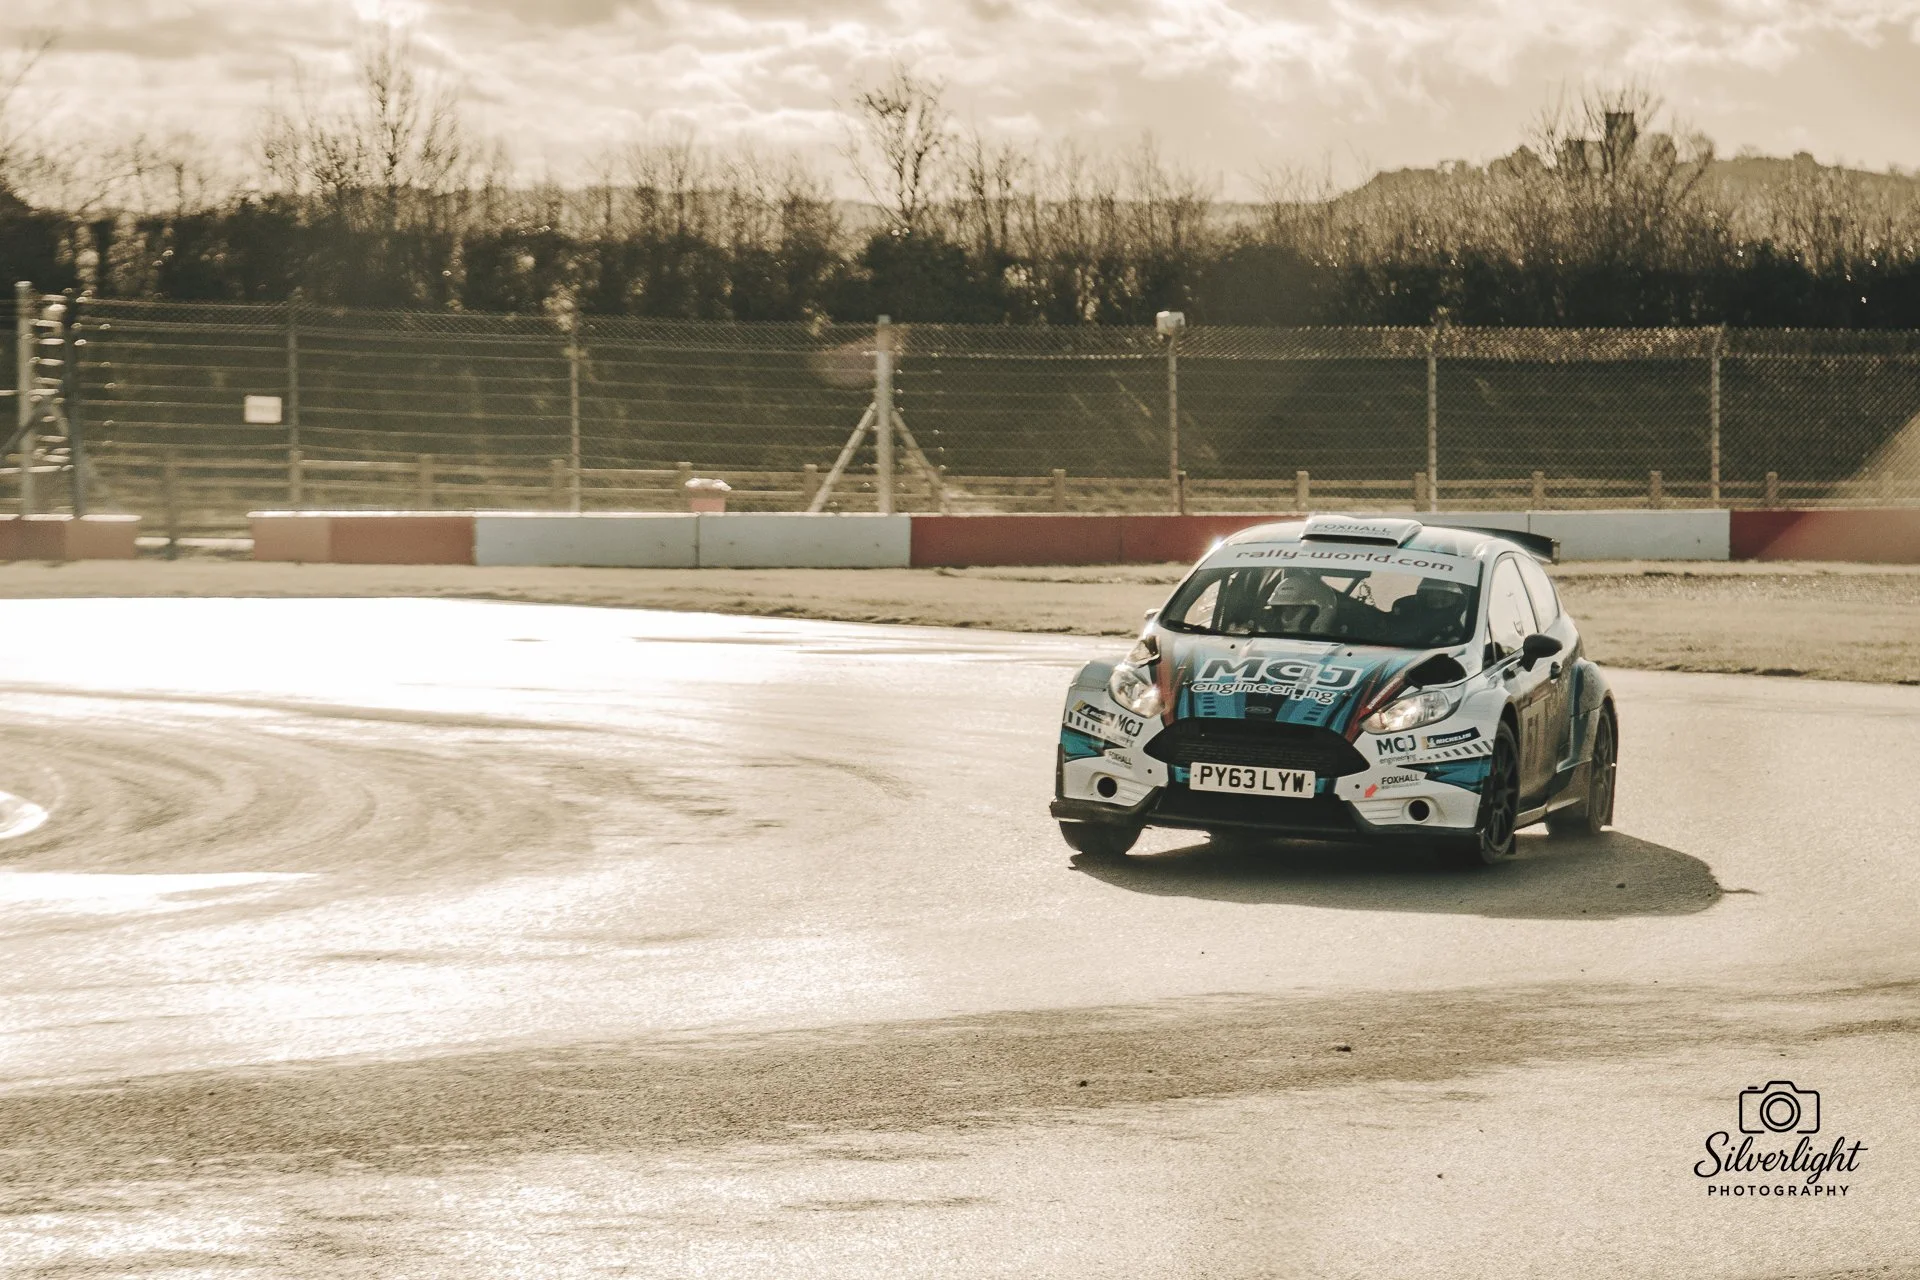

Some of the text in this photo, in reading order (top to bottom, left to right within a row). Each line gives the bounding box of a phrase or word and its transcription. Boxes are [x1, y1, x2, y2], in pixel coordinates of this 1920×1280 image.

[1236, 549, 1454, 572] rally-world.com
[1435, 732, 1472, 745] MICHELIN
[1199, 765, 1306, 793] PY63 LYW
[1381, 773, 1420, 785] FOXHALL
